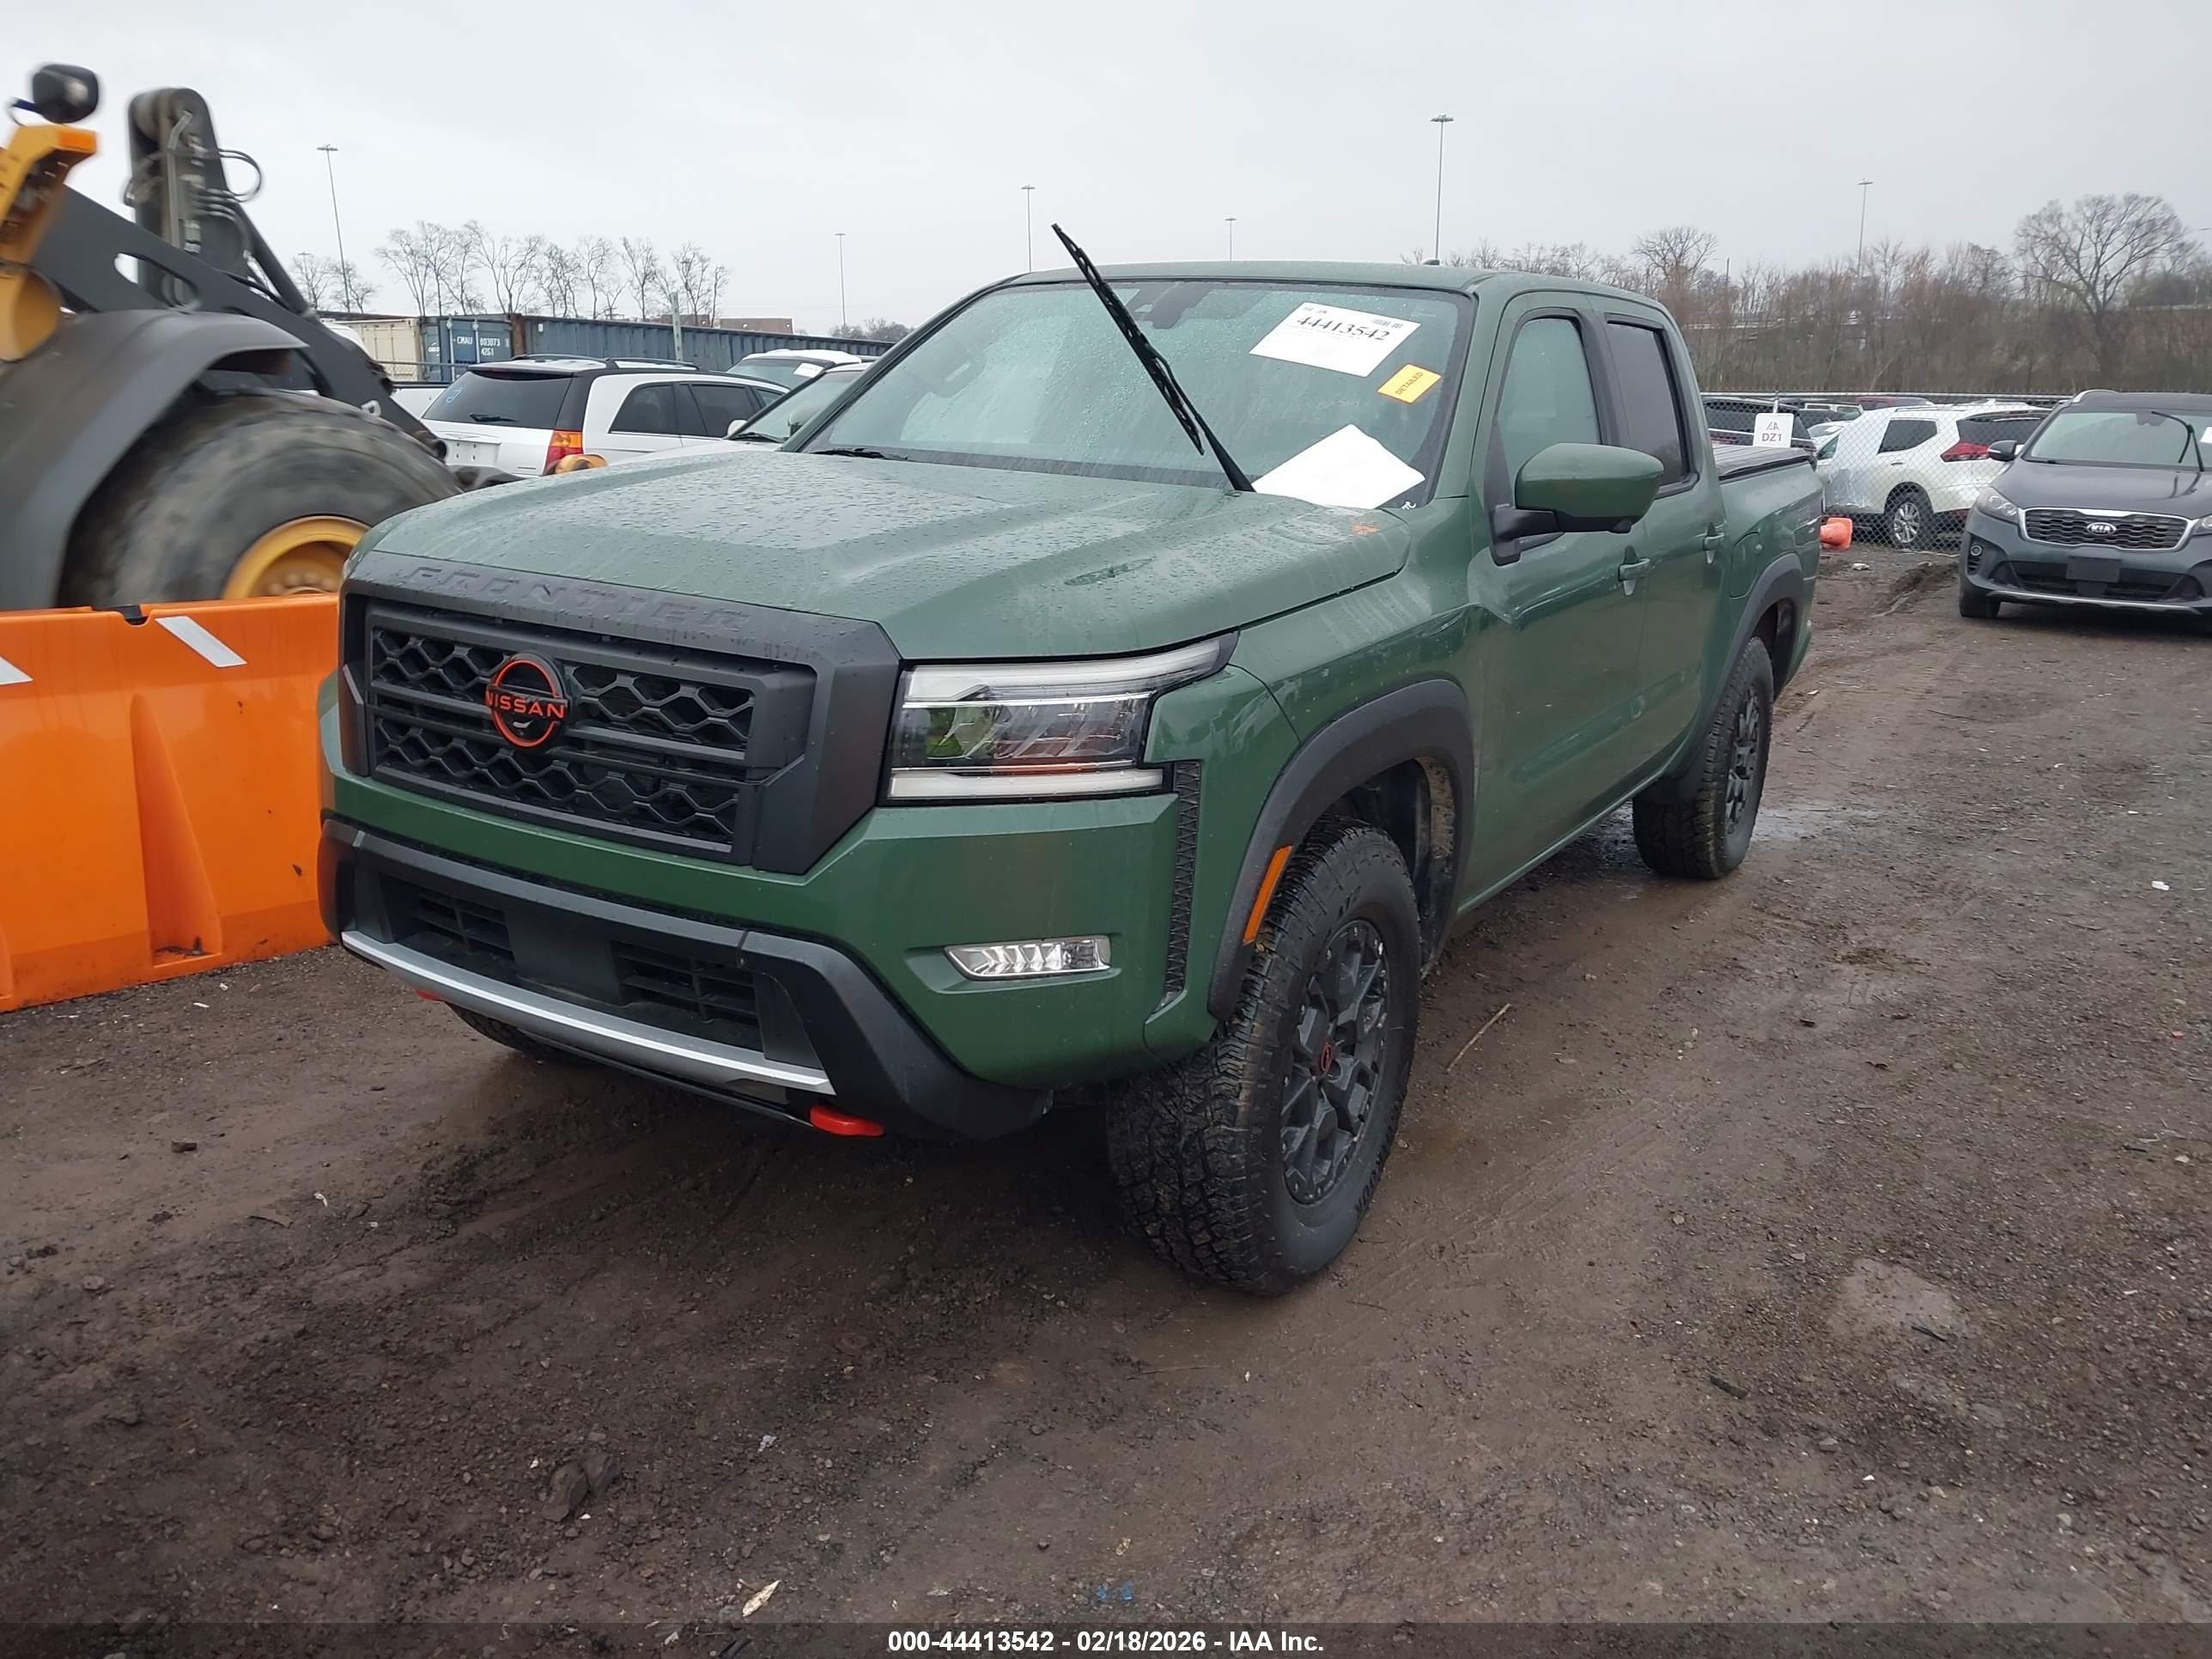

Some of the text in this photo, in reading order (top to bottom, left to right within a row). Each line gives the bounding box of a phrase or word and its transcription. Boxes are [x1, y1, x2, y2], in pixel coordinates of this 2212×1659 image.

[457, 336, 473, 345] CMAU
[1297, 316, 1390, 341] 44413542
[1395, 371, 1425, 395] DETAILED
[1761, 433, 1783, 441] DZ1
[2091, 525, 2111, 533] KIA
[405, 566, 751, 632] FRONTIER
[485, 691, 564, 719] NISSAN
